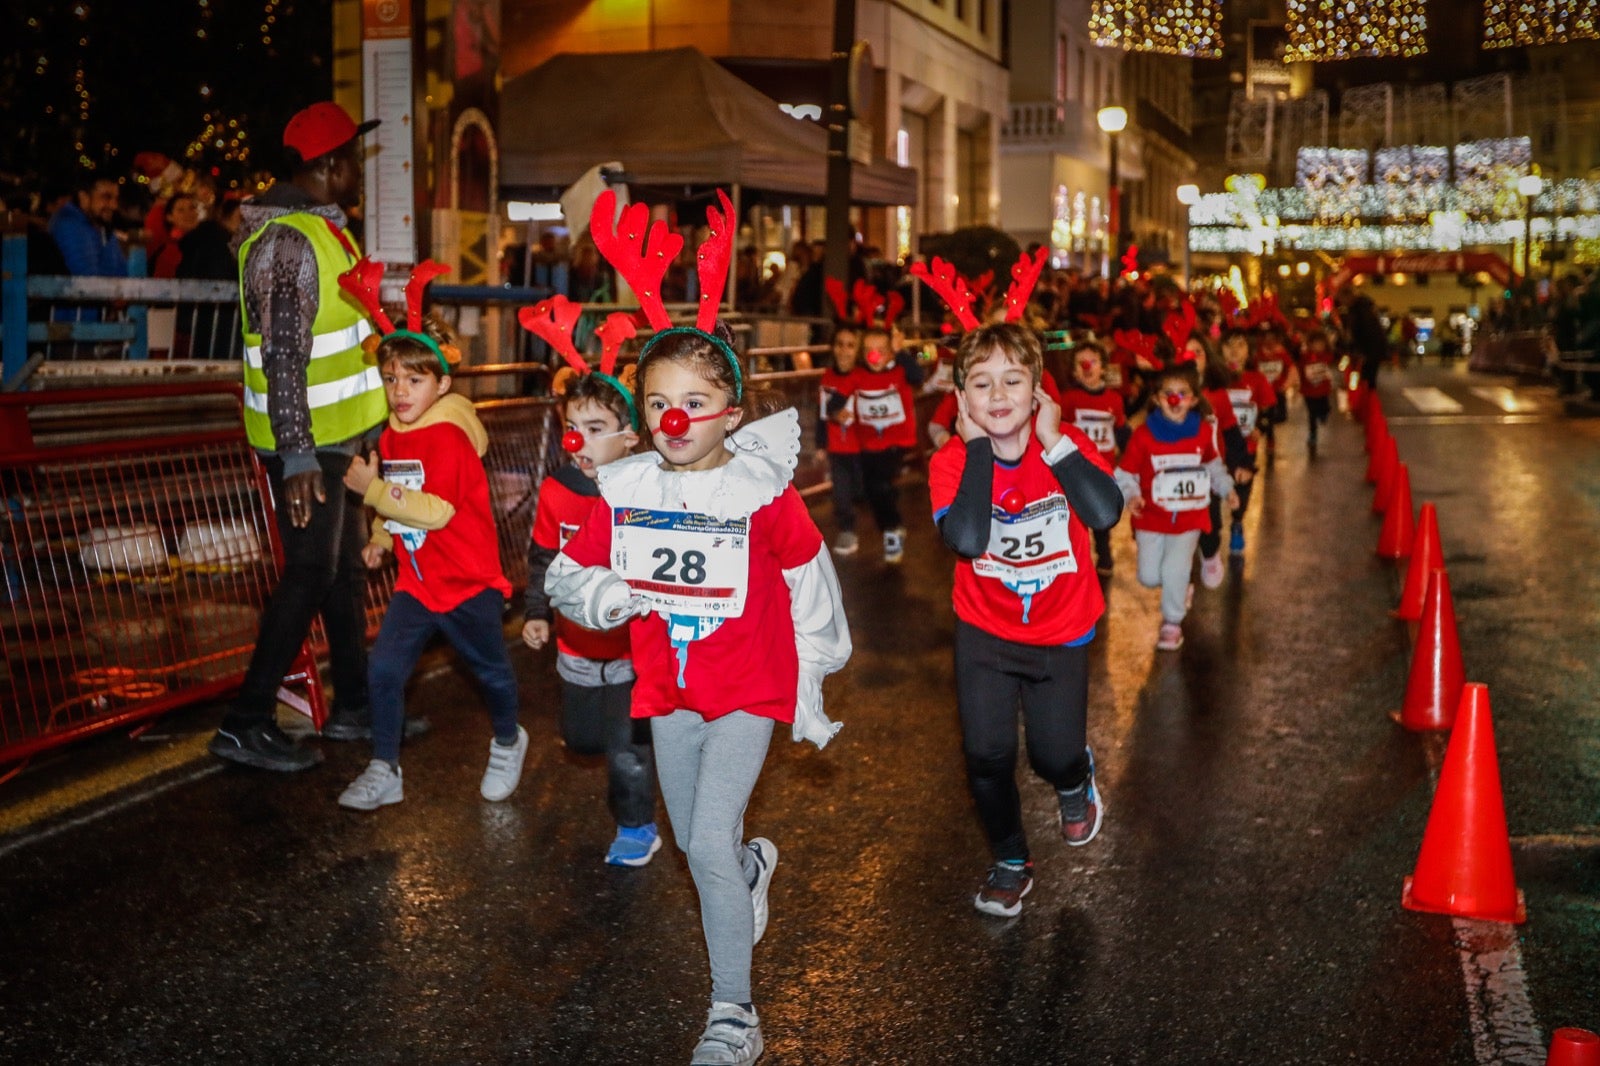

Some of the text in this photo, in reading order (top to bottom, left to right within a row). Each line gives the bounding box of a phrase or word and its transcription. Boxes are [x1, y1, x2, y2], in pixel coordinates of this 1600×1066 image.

[1173, 480, 1195, 495] 40
[1000, 531, 1045, 559] 25
[652, 547, 706, 584] 28
